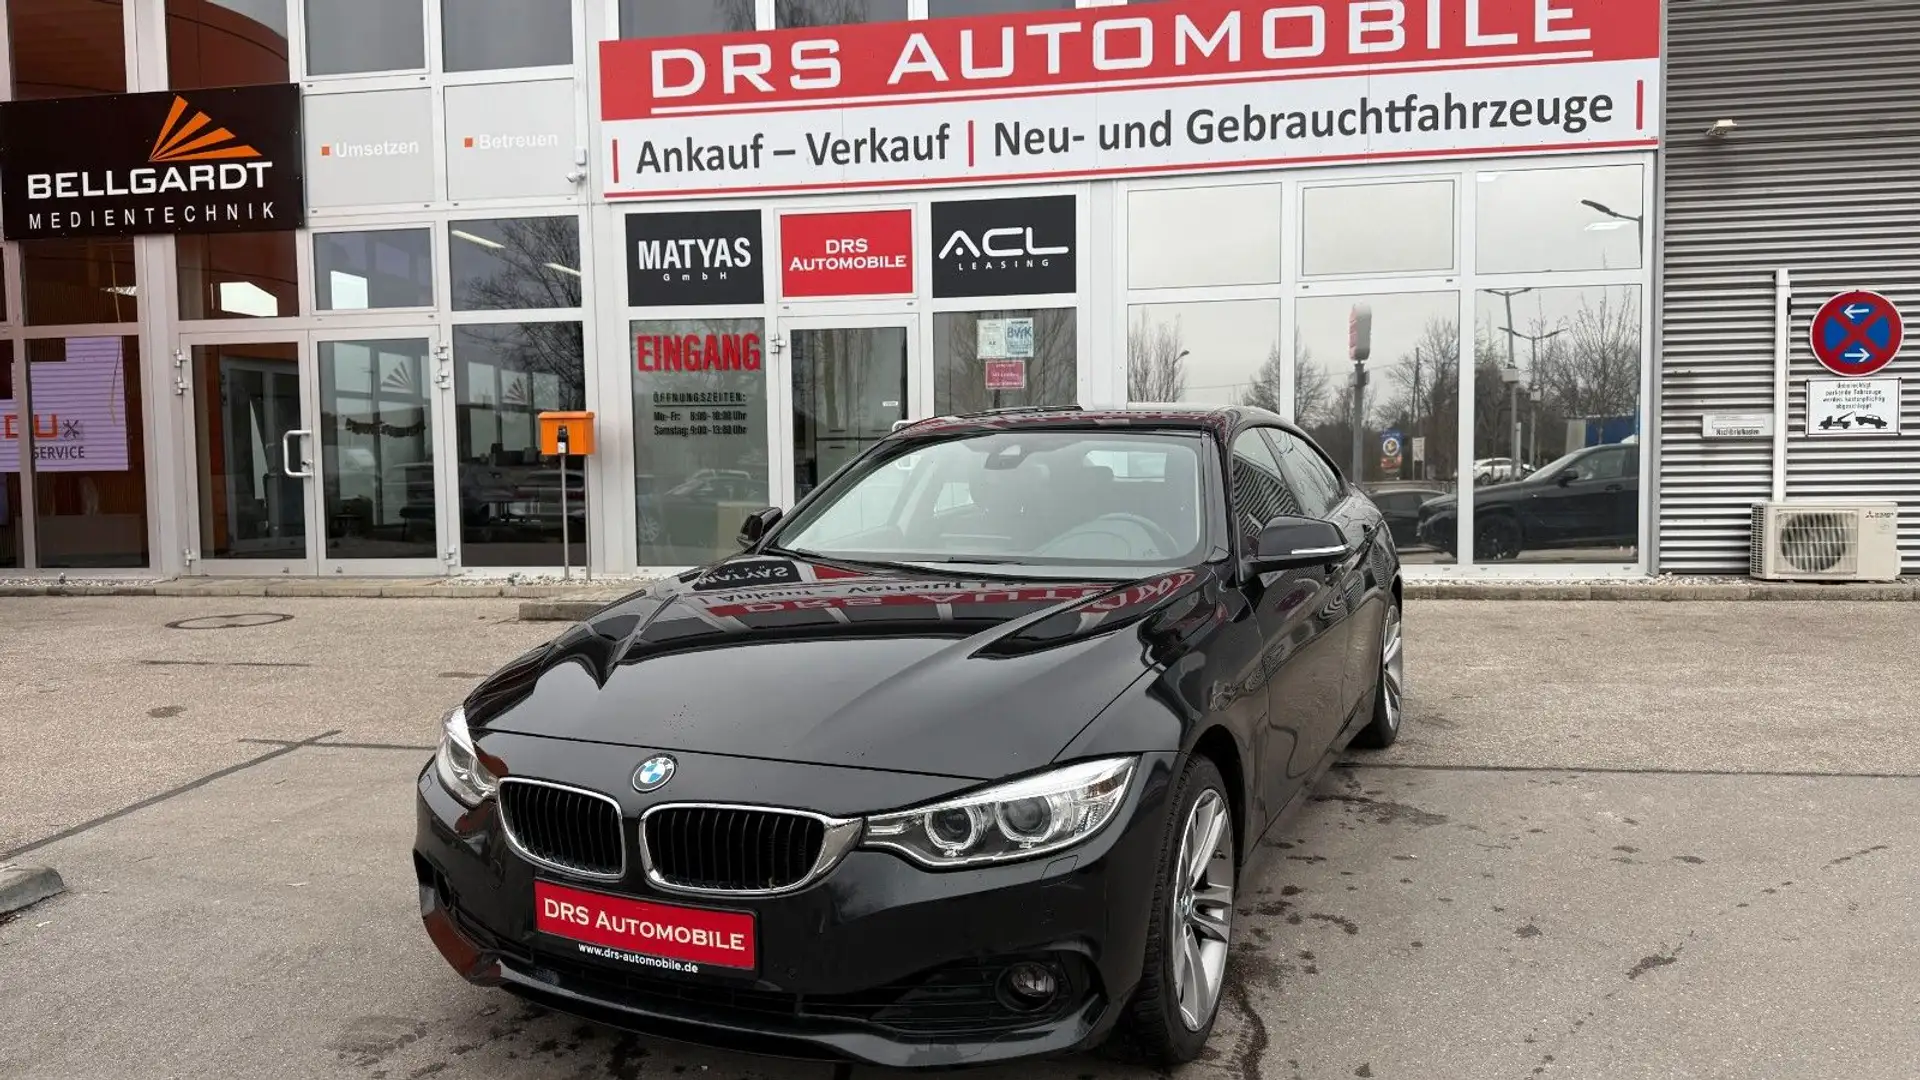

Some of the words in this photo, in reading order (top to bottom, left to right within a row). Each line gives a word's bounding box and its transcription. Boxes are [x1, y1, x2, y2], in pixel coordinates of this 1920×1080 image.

[651, 38, 842, 99] DRS
[887, 0, 1592, 85] AUTOMOBILE
[336, 137, 419, 159] Umsetzen
[479, 130, 559, 151] Betreuen
[636, 134, 764, 174] Ankauf
[806, 122, 951, 167] Verkauf
[994, 120, 1085, 157] Neu-
[1099, 109, 1172, 151] und
[1186, 91, 1614, 146] Gebrauchtfahrzeuge
[28, 161, 273, 200] BELLGARDT
[29, 200, 275, 230] MEDIENTECHNIK
[637, 236, 752, 271] MATYAS
[825, 237, 869, 255] DRS
[938, 226, 1069, 261] ACL
[789, 254, 908, 273] AUTOMOBILE
[958, 258, 1051, 271] LEASING
[637, 333, 761, 372] EINGANG
[653, 391, 747, 403] ÖFFNUNGSZEITEN:
[33, 445, 86, 460] SERVICE
[543, 897, 590, 926] DRS
[595, 909, 746, 951] AUTOMOBILE
[578, 942, 699, 974] www.drs-automobile.de
